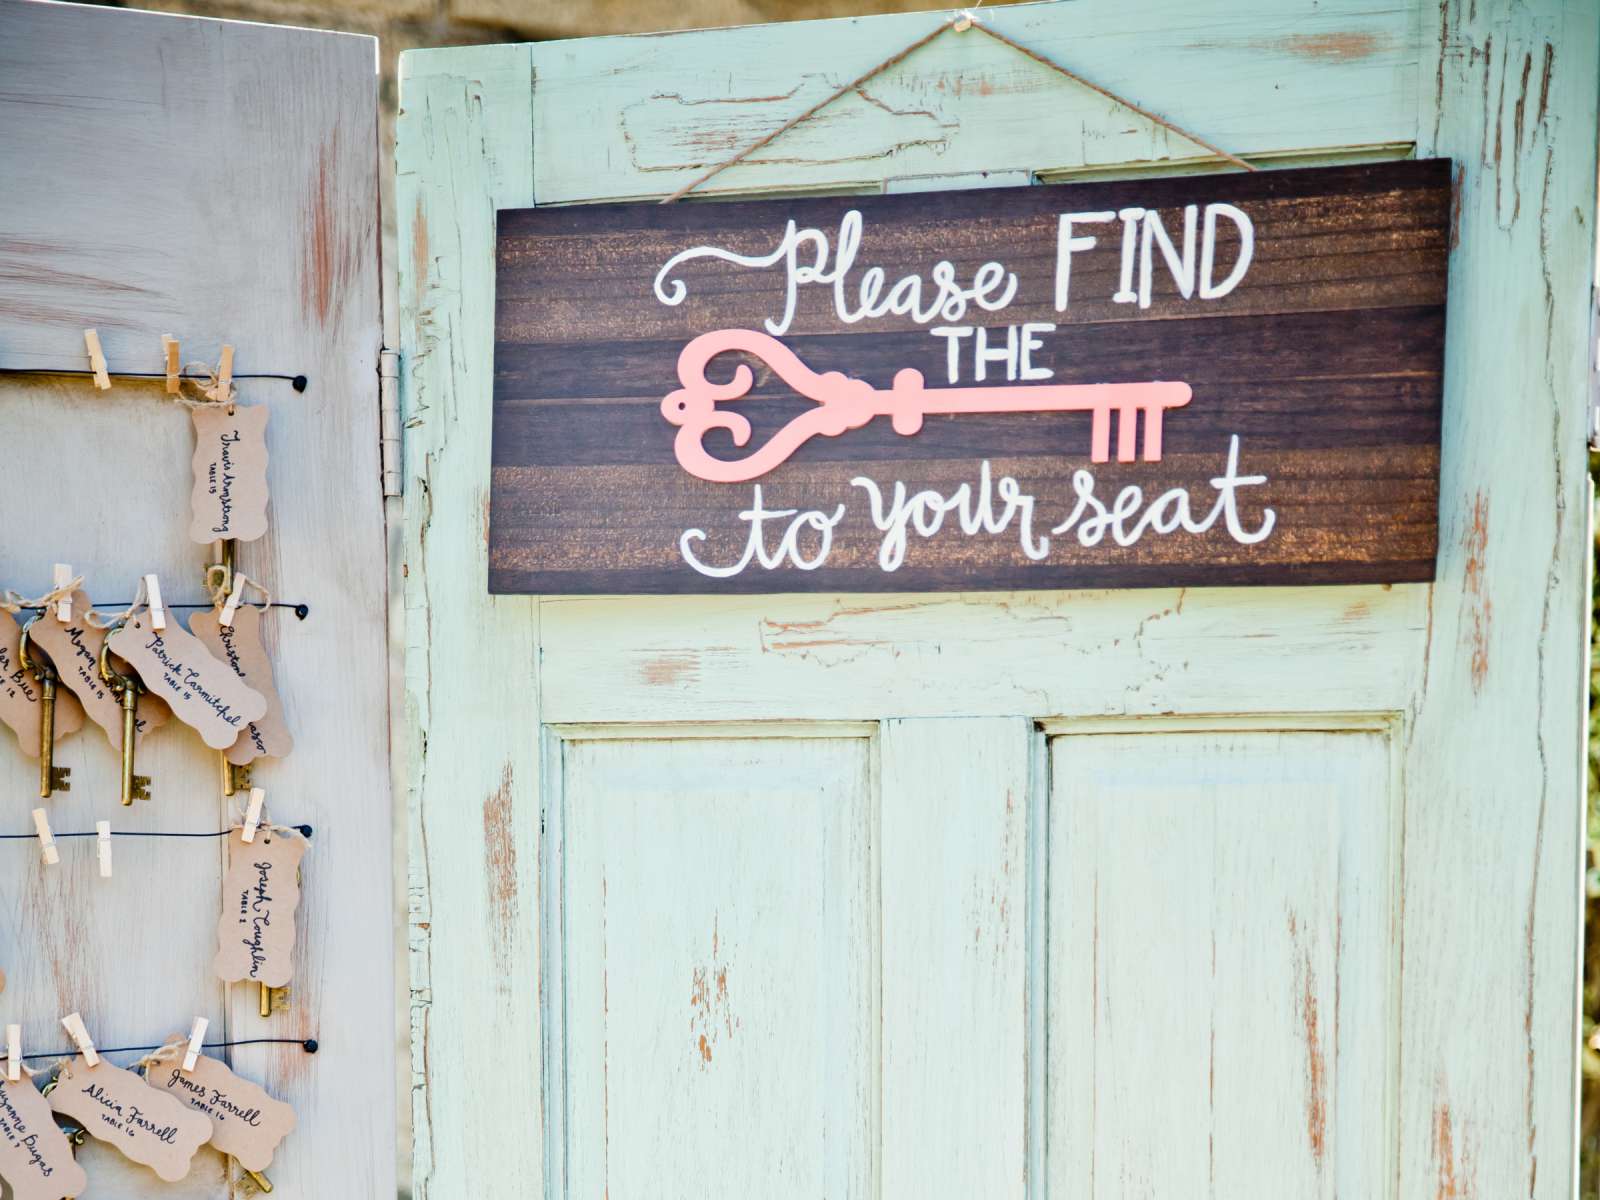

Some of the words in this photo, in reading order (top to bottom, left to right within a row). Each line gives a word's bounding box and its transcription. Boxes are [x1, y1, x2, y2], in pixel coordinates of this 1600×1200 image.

[654, 210, 1016, 335] Please
[1055, 203, 1253, 311] FIND
[931, 323, 1057, 382] THE
[220, 429, 241, 471] Travis
[208, 461, 217, 484] TABLE
[209, 471, 236, 533] Armstrong
[680, 483, 844, 577] to
[851, 461, 1050, 572] your
[1052, 434, 1275, 546] seat
[63, 627, 97, 671] Megan
[146, 632, 182, 676] Patrick
[10, 670, 37, 702] Bue
[77, 665, 97, 691] TABLE
[163, 672, 180, 693] TABLE
[240, 889, 250, 915] TABLE
[251, 861, 273, 915] Joseph
[242, 909, 271, 978] Coughlin
[81, 1083, 123, 1117] Alicia
[125, 1105, 178, 1145] Farrell
[168, 1069, 206, 1098] James
[209, 1089, 262, 1127] Farrell
[190, 1097, 214, 1115] TABLE
[101, 1113, 124, 1130] TABLE
